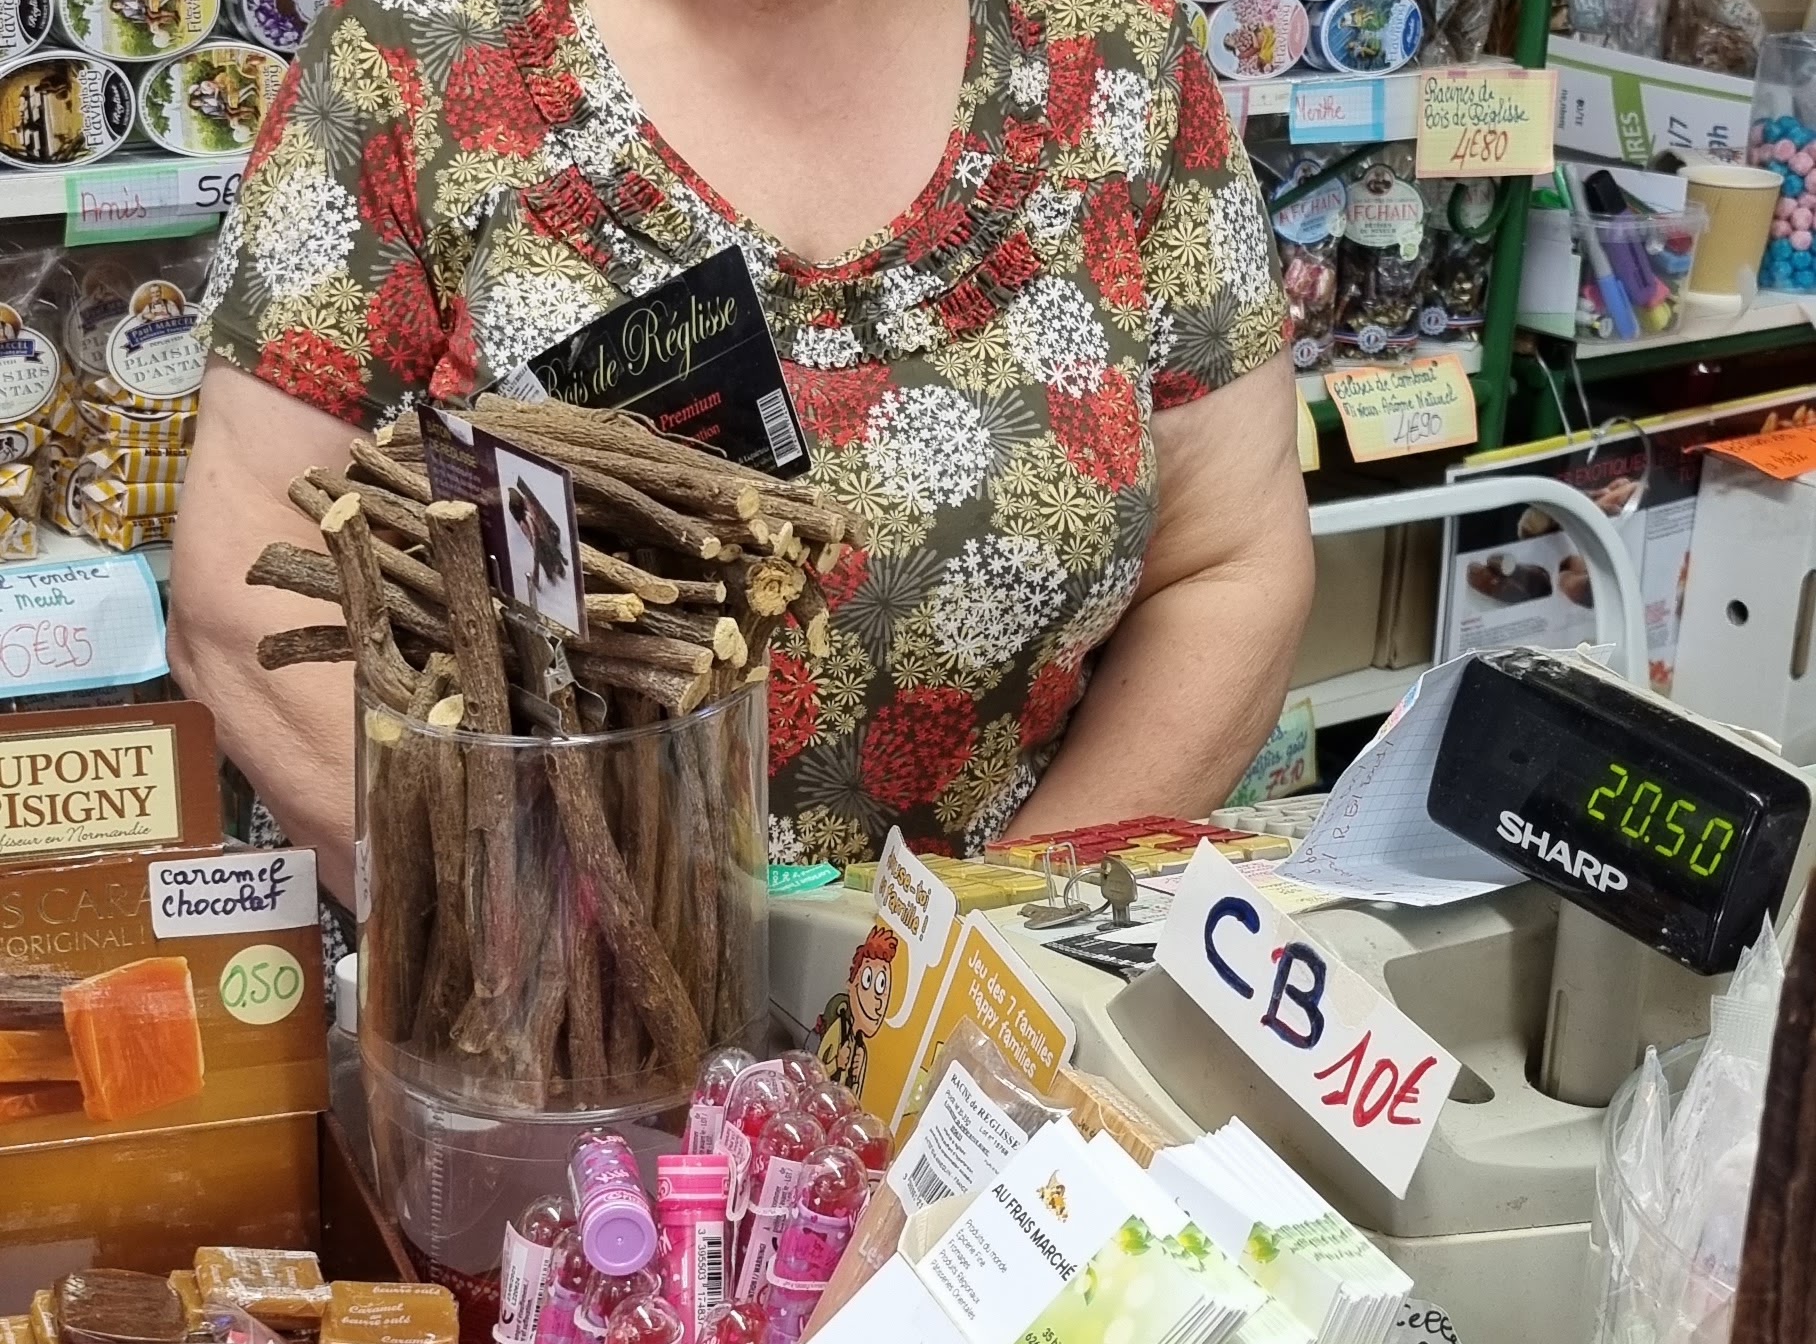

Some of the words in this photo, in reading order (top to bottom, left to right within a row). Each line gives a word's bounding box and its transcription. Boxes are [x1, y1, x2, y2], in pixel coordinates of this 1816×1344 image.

[1294, 94, 1346, 121] Menthe
[1450, 126, 1510, 169] 4€80
[535, 357, 589, 406] Bois
[593, 344, 619, 397] de
[622, 294, 739, 382] Réglisse
[658, 389, 723, 433] Premium
[17, 563, 110, 587] Tendre
[0, 620, 94, 679] 6€95
[66, 821, 152, 844] Normandie
[1586, 762, 1735, 877] 20.50
[160, 857, 294, 887] caramel
[1496, 809, 1629, 894] SHARP
[161, 885, 287, 919] chocolat
[968, 949, 988, 979] Jeu
[986, 970, 1007, 1002] des
[1013, 1008, 1055, 1069] familles
[968, 979, 1000, 1031] Happy
[997, 1021, 1037, 1081] families
[1311, 1029, 1439, 1129] 10€
[976, 1108, 1022, 1152] REGLISSE
[948, 1239, 971, 1270] Fromages
[965, 1218, 986, 1246] Produits
[989, 1249, 1009, 1274] monde
[991, 1182, 1010, 1204] AU
[1005, 1200, 1037, 1235] FRAIS
[1028, 1227, 1079, 1283] MARCHÉ
[349, 1302, 404, 1314] Caramel
[1041, 1327, 1053, 1344] 35
